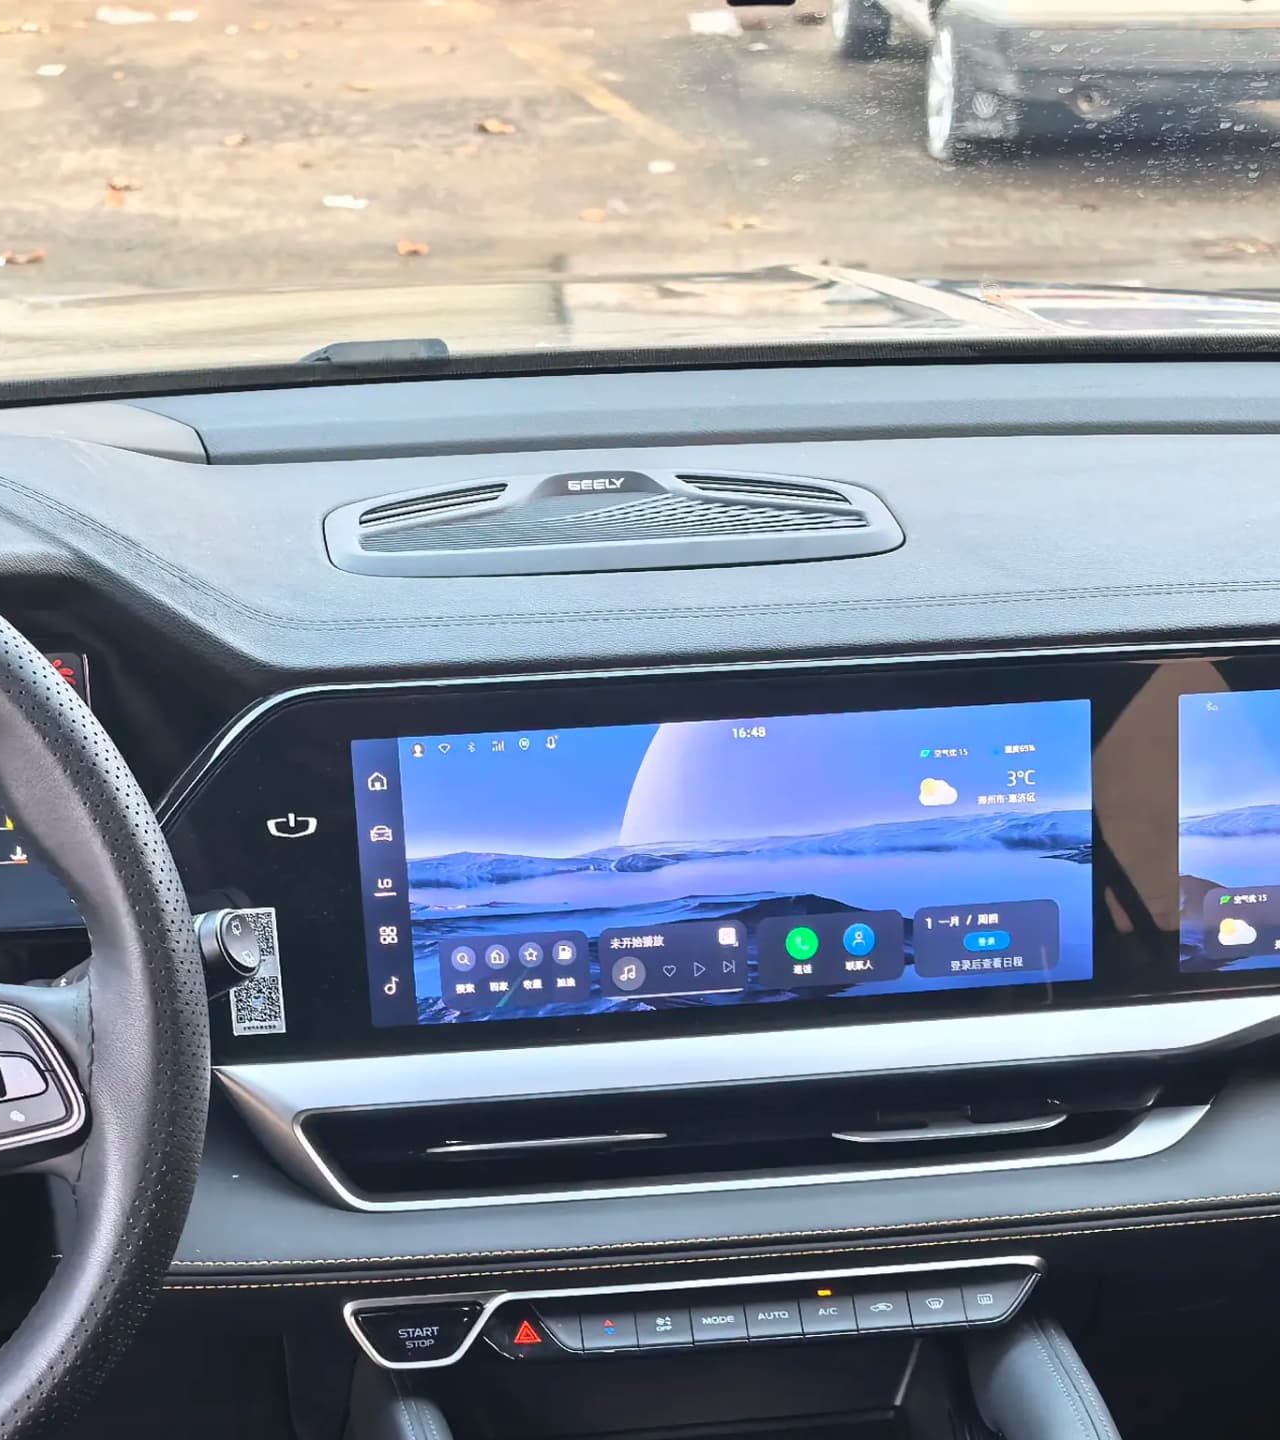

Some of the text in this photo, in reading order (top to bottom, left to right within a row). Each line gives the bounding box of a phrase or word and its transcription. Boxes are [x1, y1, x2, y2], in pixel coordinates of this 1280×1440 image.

[567, 478, 625, 491] GEELY
[732, 726, 766, 739] 16:48
[757, 1310, 789, 1321] AUTO
[818, 1307, 839, 1317] A/C
[702, 1315, 735, 1325] MODE
[398, 1326, 440, 1339] START
[405, 1338, 435, 1349] STOP
